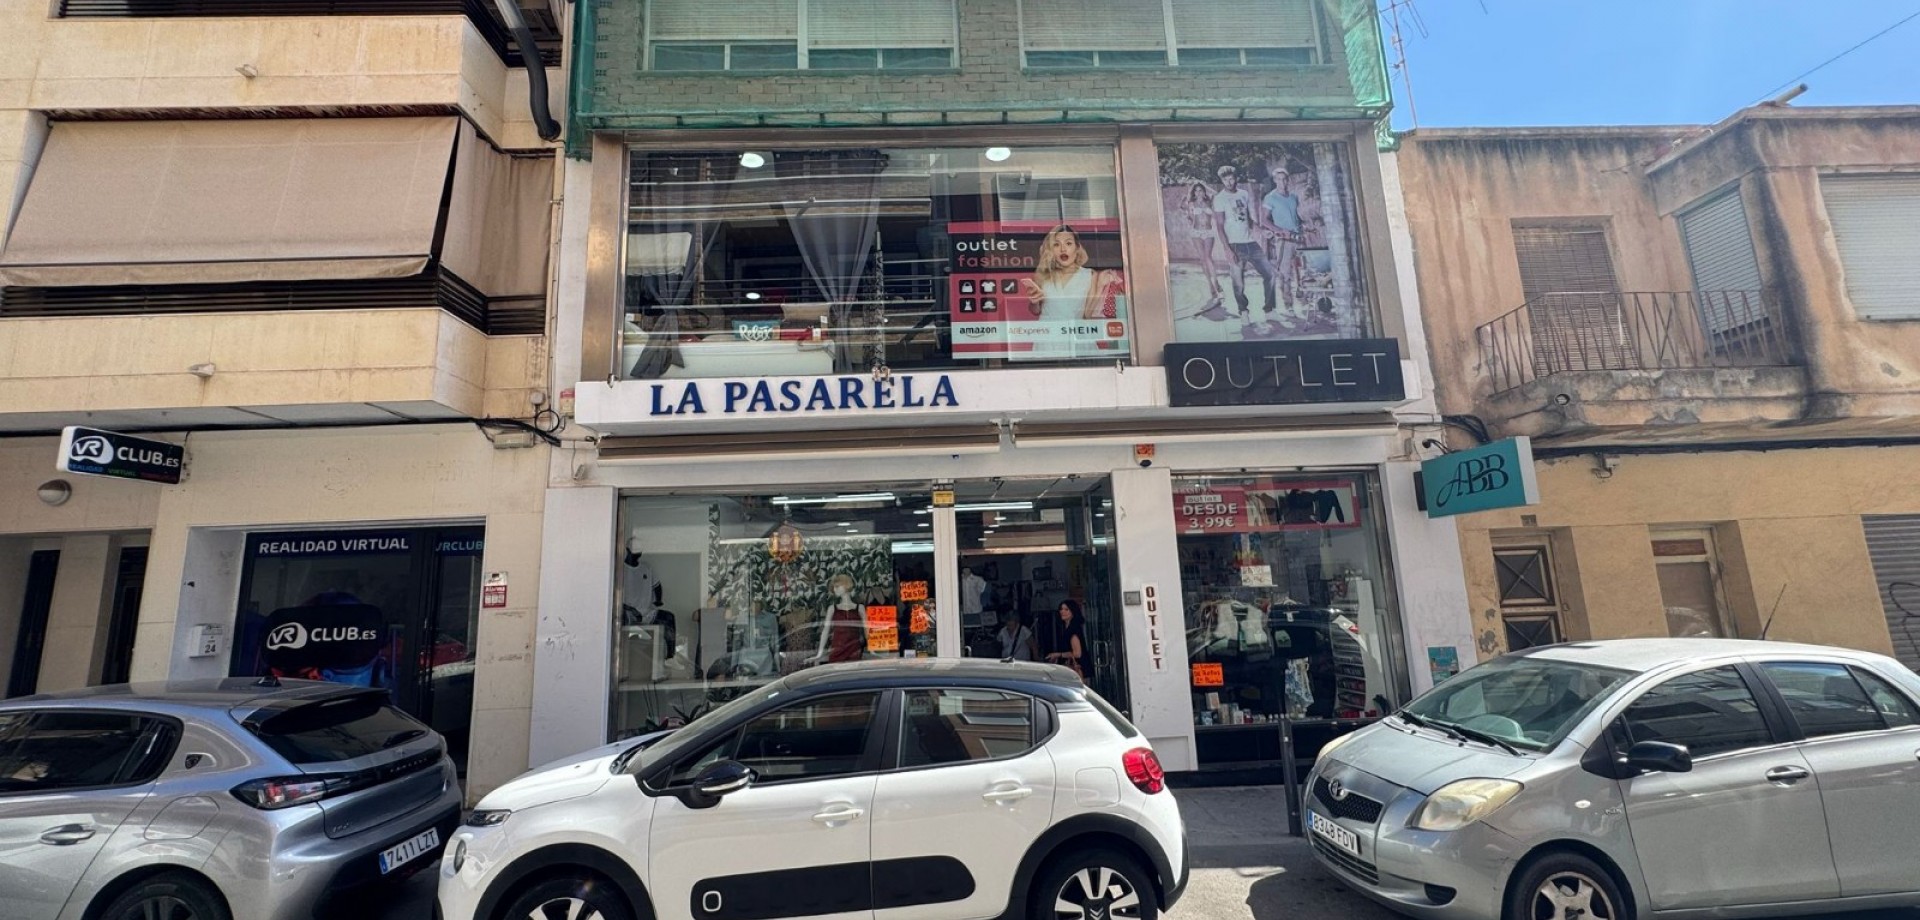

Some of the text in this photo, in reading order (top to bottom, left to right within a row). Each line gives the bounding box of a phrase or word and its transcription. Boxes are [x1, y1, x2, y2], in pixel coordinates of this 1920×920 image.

[956, 238, 1018, 251] outlet
[958, 254, 1034, 268] fashion
[959, 326, 997, 335] amazon
[1061, 326, 1099, 335] SHEIN
[1183, 352, 1387, 390] OUTLET
[650, 375, 960, 416] LA PASARELA
[1436, 453, 1509, 507] ABB
[1182, 503, 1238, 516] DESDE
[1189, 516, 1235, 529] 3.99€
[259, 537, 409, 554] REALIDAD VIRTUAL
[271, 627, 296, 644] VR
[1145, 586, 1162, 670] OUTLET
[387, 830, 436, 868] 7411 LZT
